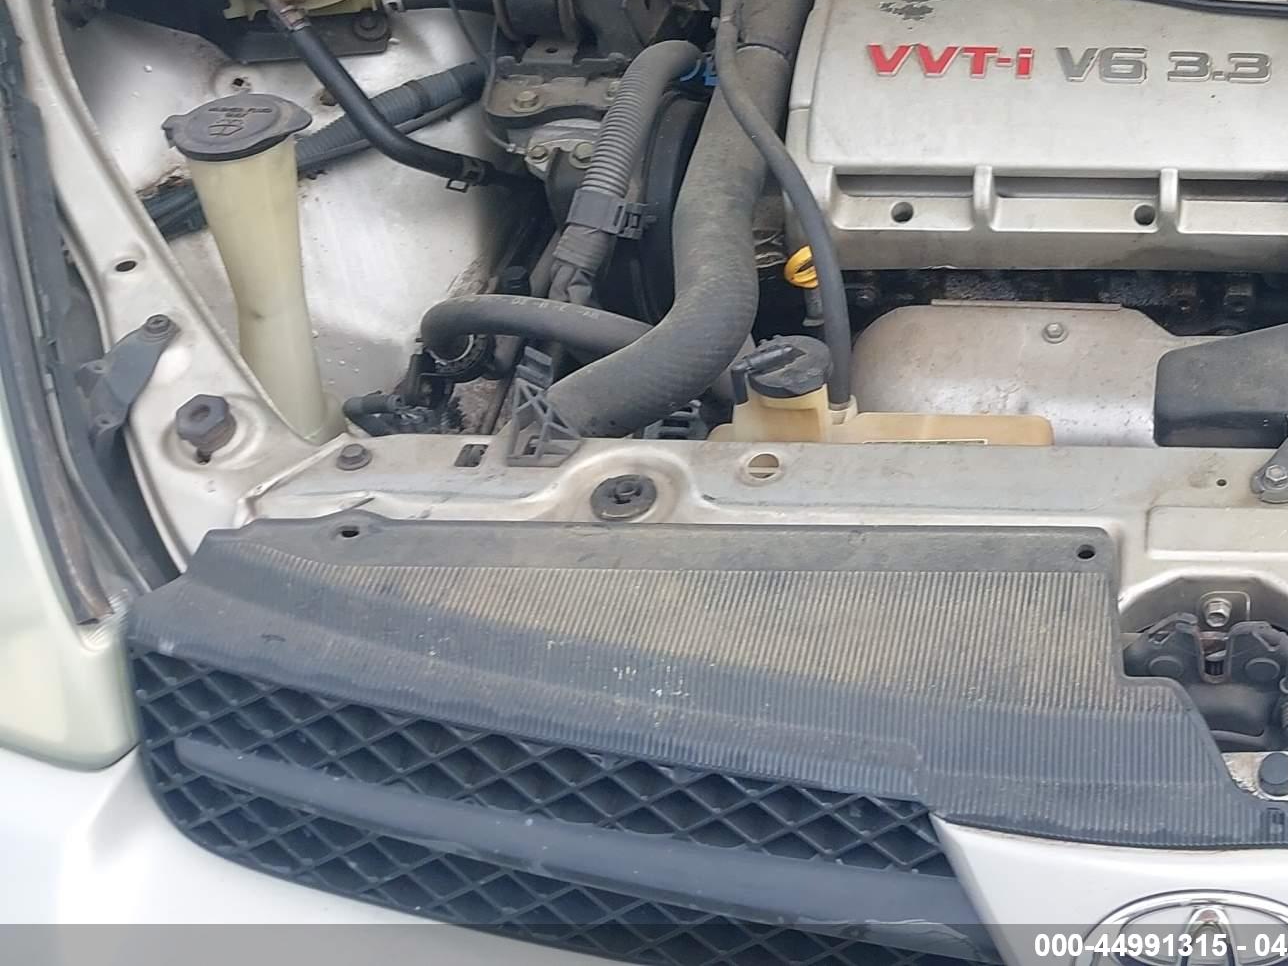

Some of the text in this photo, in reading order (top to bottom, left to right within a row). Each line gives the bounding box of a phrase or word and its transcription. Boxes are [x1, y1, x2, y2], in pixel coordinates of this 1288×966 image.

[867, 44, 1273, 84] VVT-i V6 3.3
